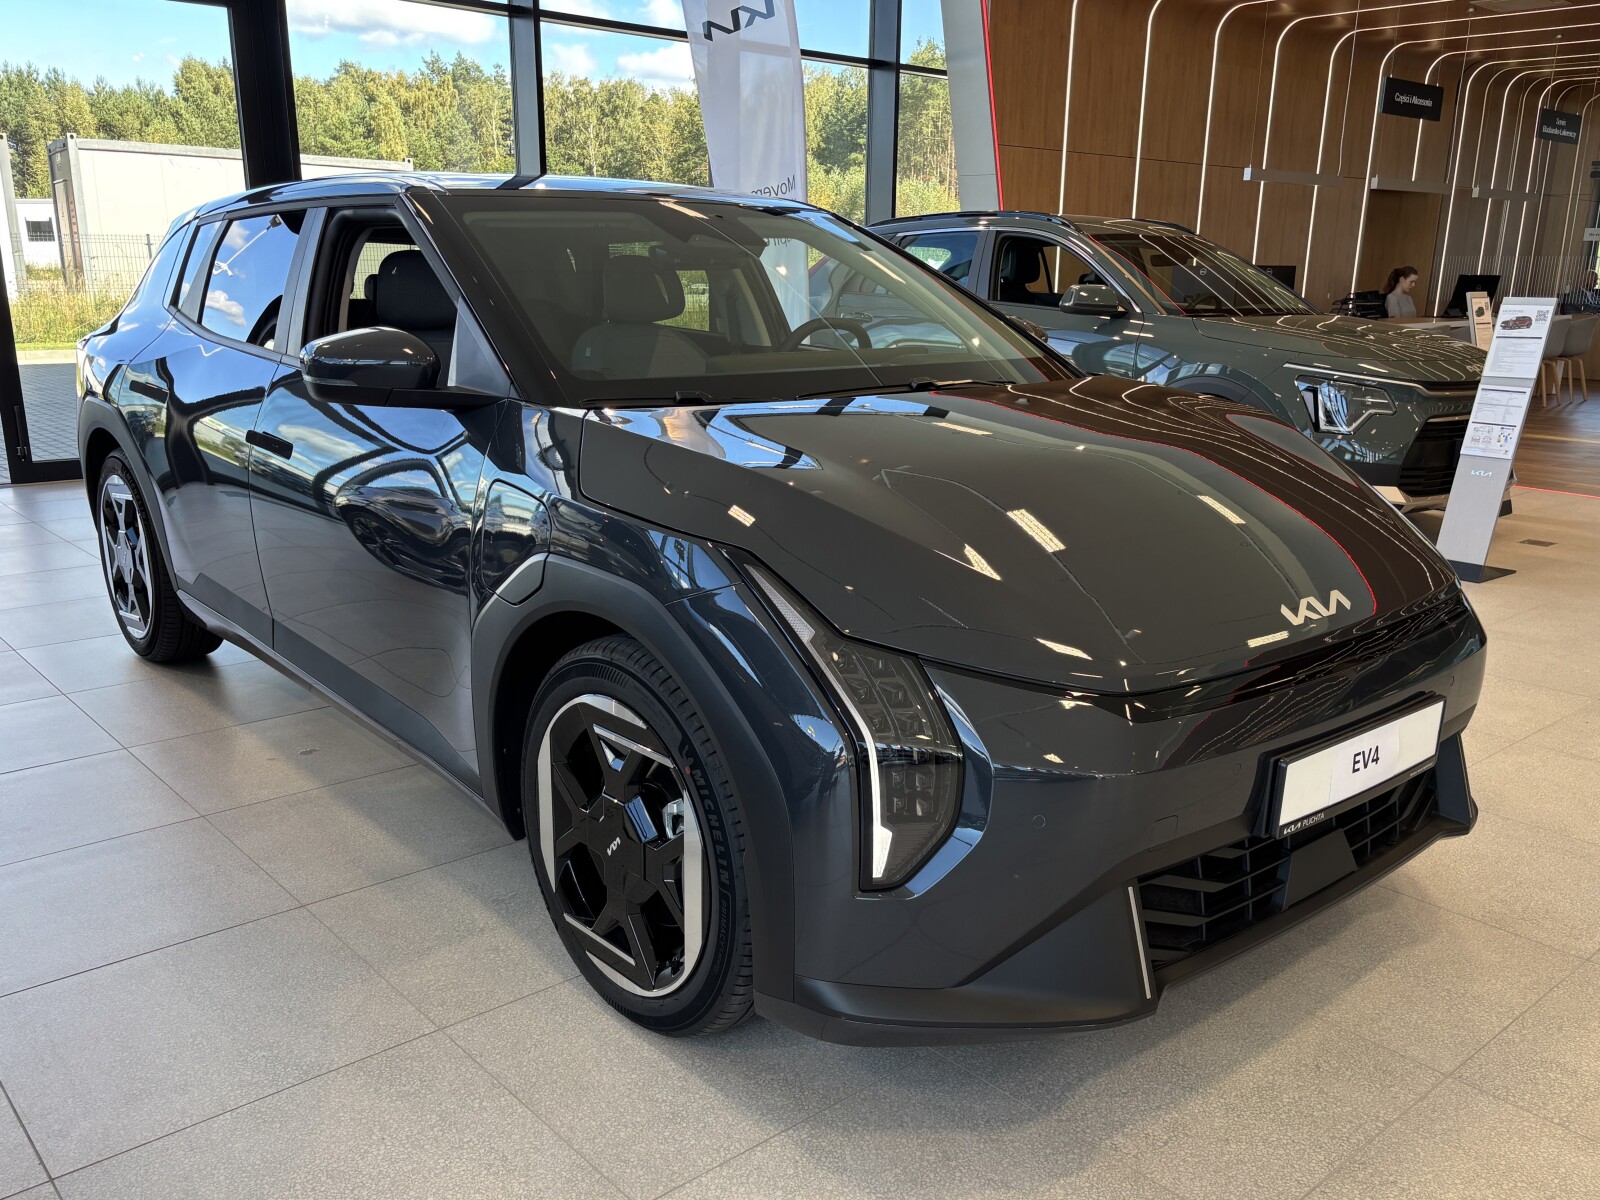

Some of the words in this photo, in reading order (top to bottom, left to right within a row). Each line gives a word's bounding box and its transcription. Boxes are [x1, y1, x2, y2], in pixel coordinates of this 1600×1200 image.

[1471, 469, 1493, 477] KIA
[1280, 589, 1351, 626] KIA
[1352, 745, 1380, 774] EV4
[692, 769, 731, 887] MICHELIN
[1283, 823, 1301, 835] KIA
[1302, 812, 1325, 827] PLICHTA
[606, 836, 621, 857] KIA
